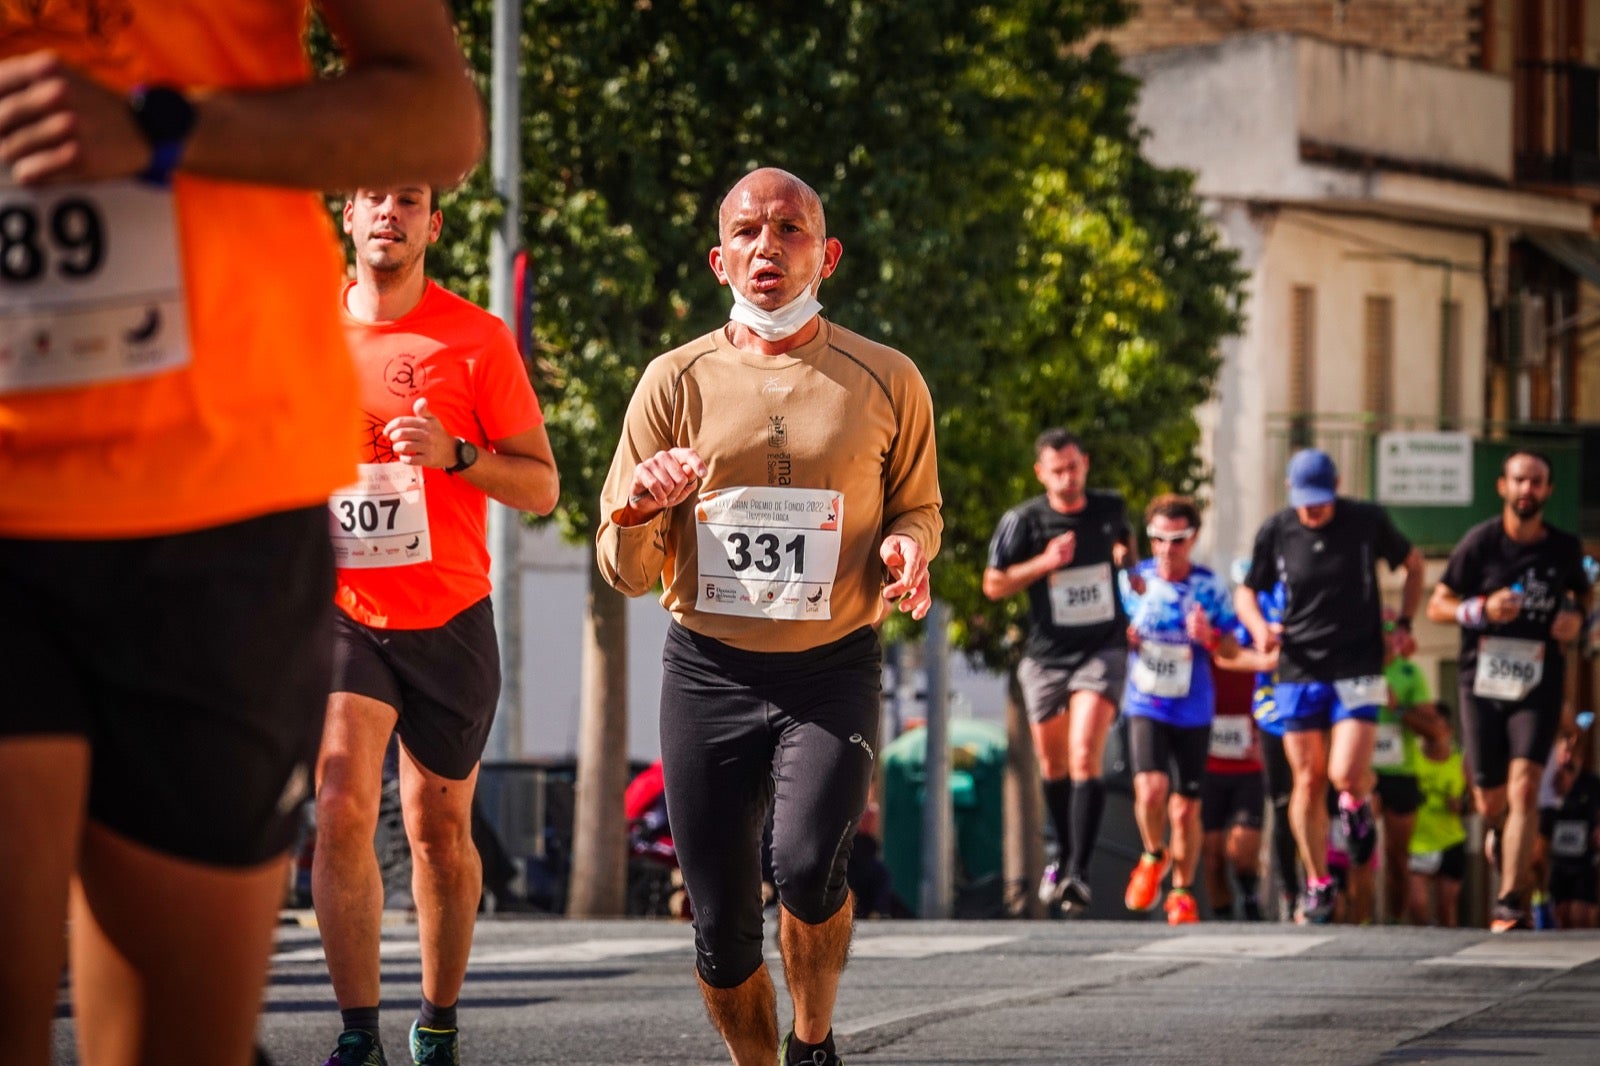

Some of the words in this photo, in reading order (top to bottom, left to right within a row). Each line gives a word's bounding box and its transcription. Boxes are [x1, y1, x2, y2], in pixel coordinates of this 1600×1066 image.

[340, 498, 401, 532] 307
[806, 501, 825, 513] 2022
[728, 532, 806, 574] 331
